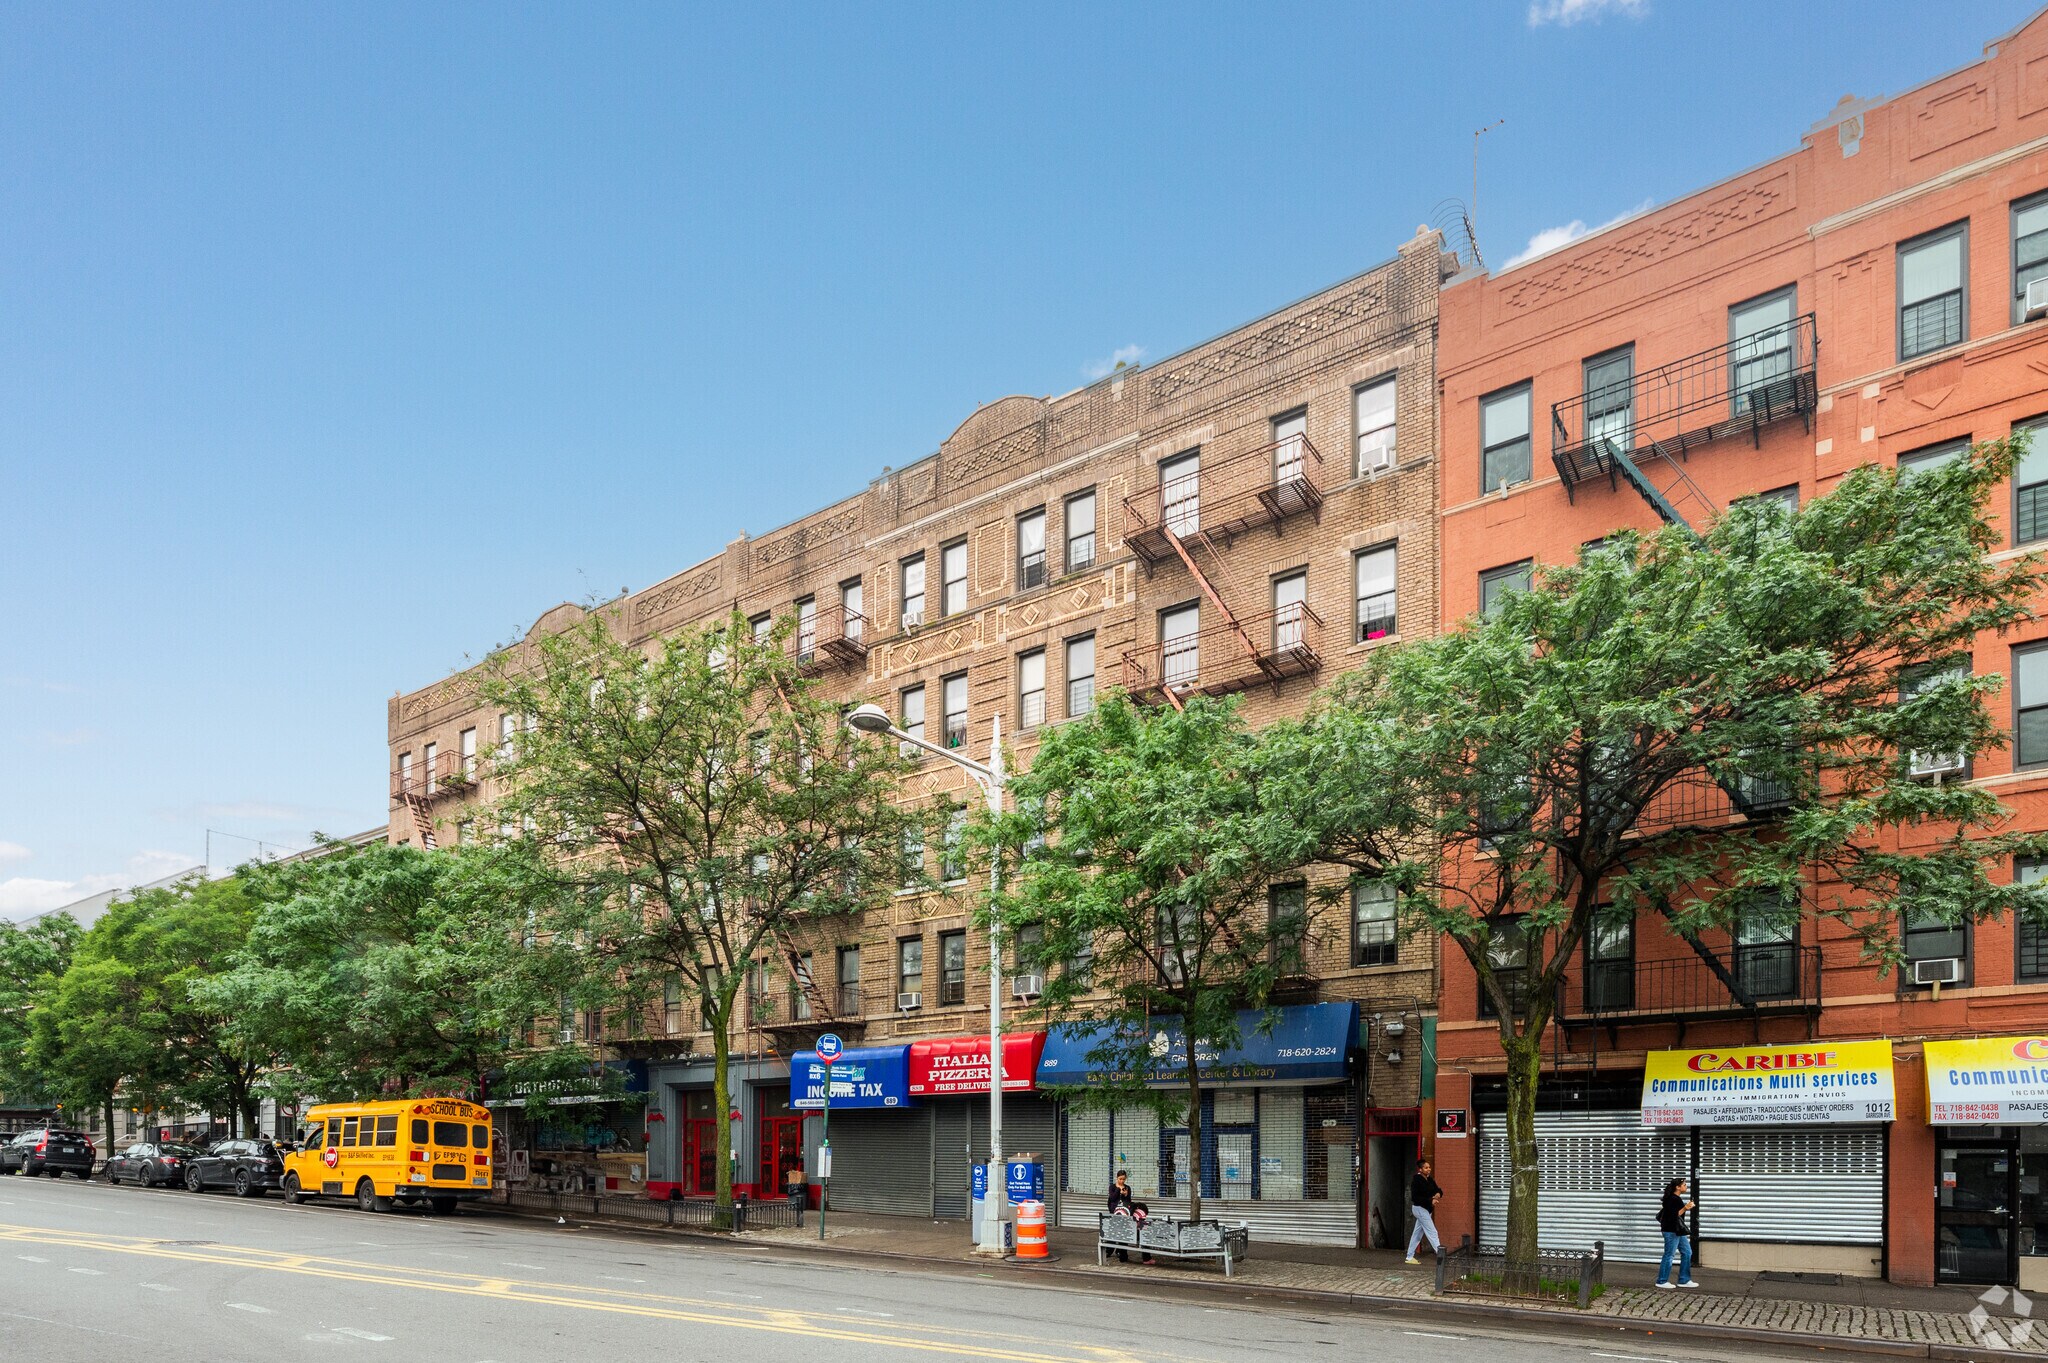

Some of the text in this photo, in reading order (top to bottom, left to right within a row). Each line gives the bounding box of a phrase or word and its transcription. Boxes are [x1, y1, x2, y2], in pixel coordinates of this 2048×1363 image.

[1171, 1052, 1220, 1062] CHIDREN
[1277, 1047, 1337, 1058] 718-620-2824
[933, 1054, 1003, 1068] ITALIA
[1044, 1059, 1058, 1067] 889
[1687, 1052, 1838, 1073] CARIBE
[928, 1067, 1009, 1081] PIZZERA
[1232, 1068, 1240, 1077] &
[934, 1081, 992, 1091] FREE DELIVER
[1652, 1071, 1878, 1093] Communications Multi services
[859, 1083, 883, 1097] TAX
[430, 1104, 474, 1118] SCHOOL BUS
[1693, 1107, 1717, 1115] PASAJES
[1757, 1105, 1801, 1113] TRADUCCIONES
[1806, 1104, 1827, 1112] MONEY
[1828, 1103, 1854, 1111] ORDERS
[1865, 1103, 1890, 1112] 1012
[1950, 1104, 1999, 1112] 718-842-0438
[1740, 1114, 1765, 1122] NOTARIO
[1769, 1113, 1789, 1121] PAGUE
[1803, 1112, 1830, 1120] CUENTAS
[1950, 1112, 1999, 1120] 718-842-0420
[326, 1153, 336, 1161] STOP
